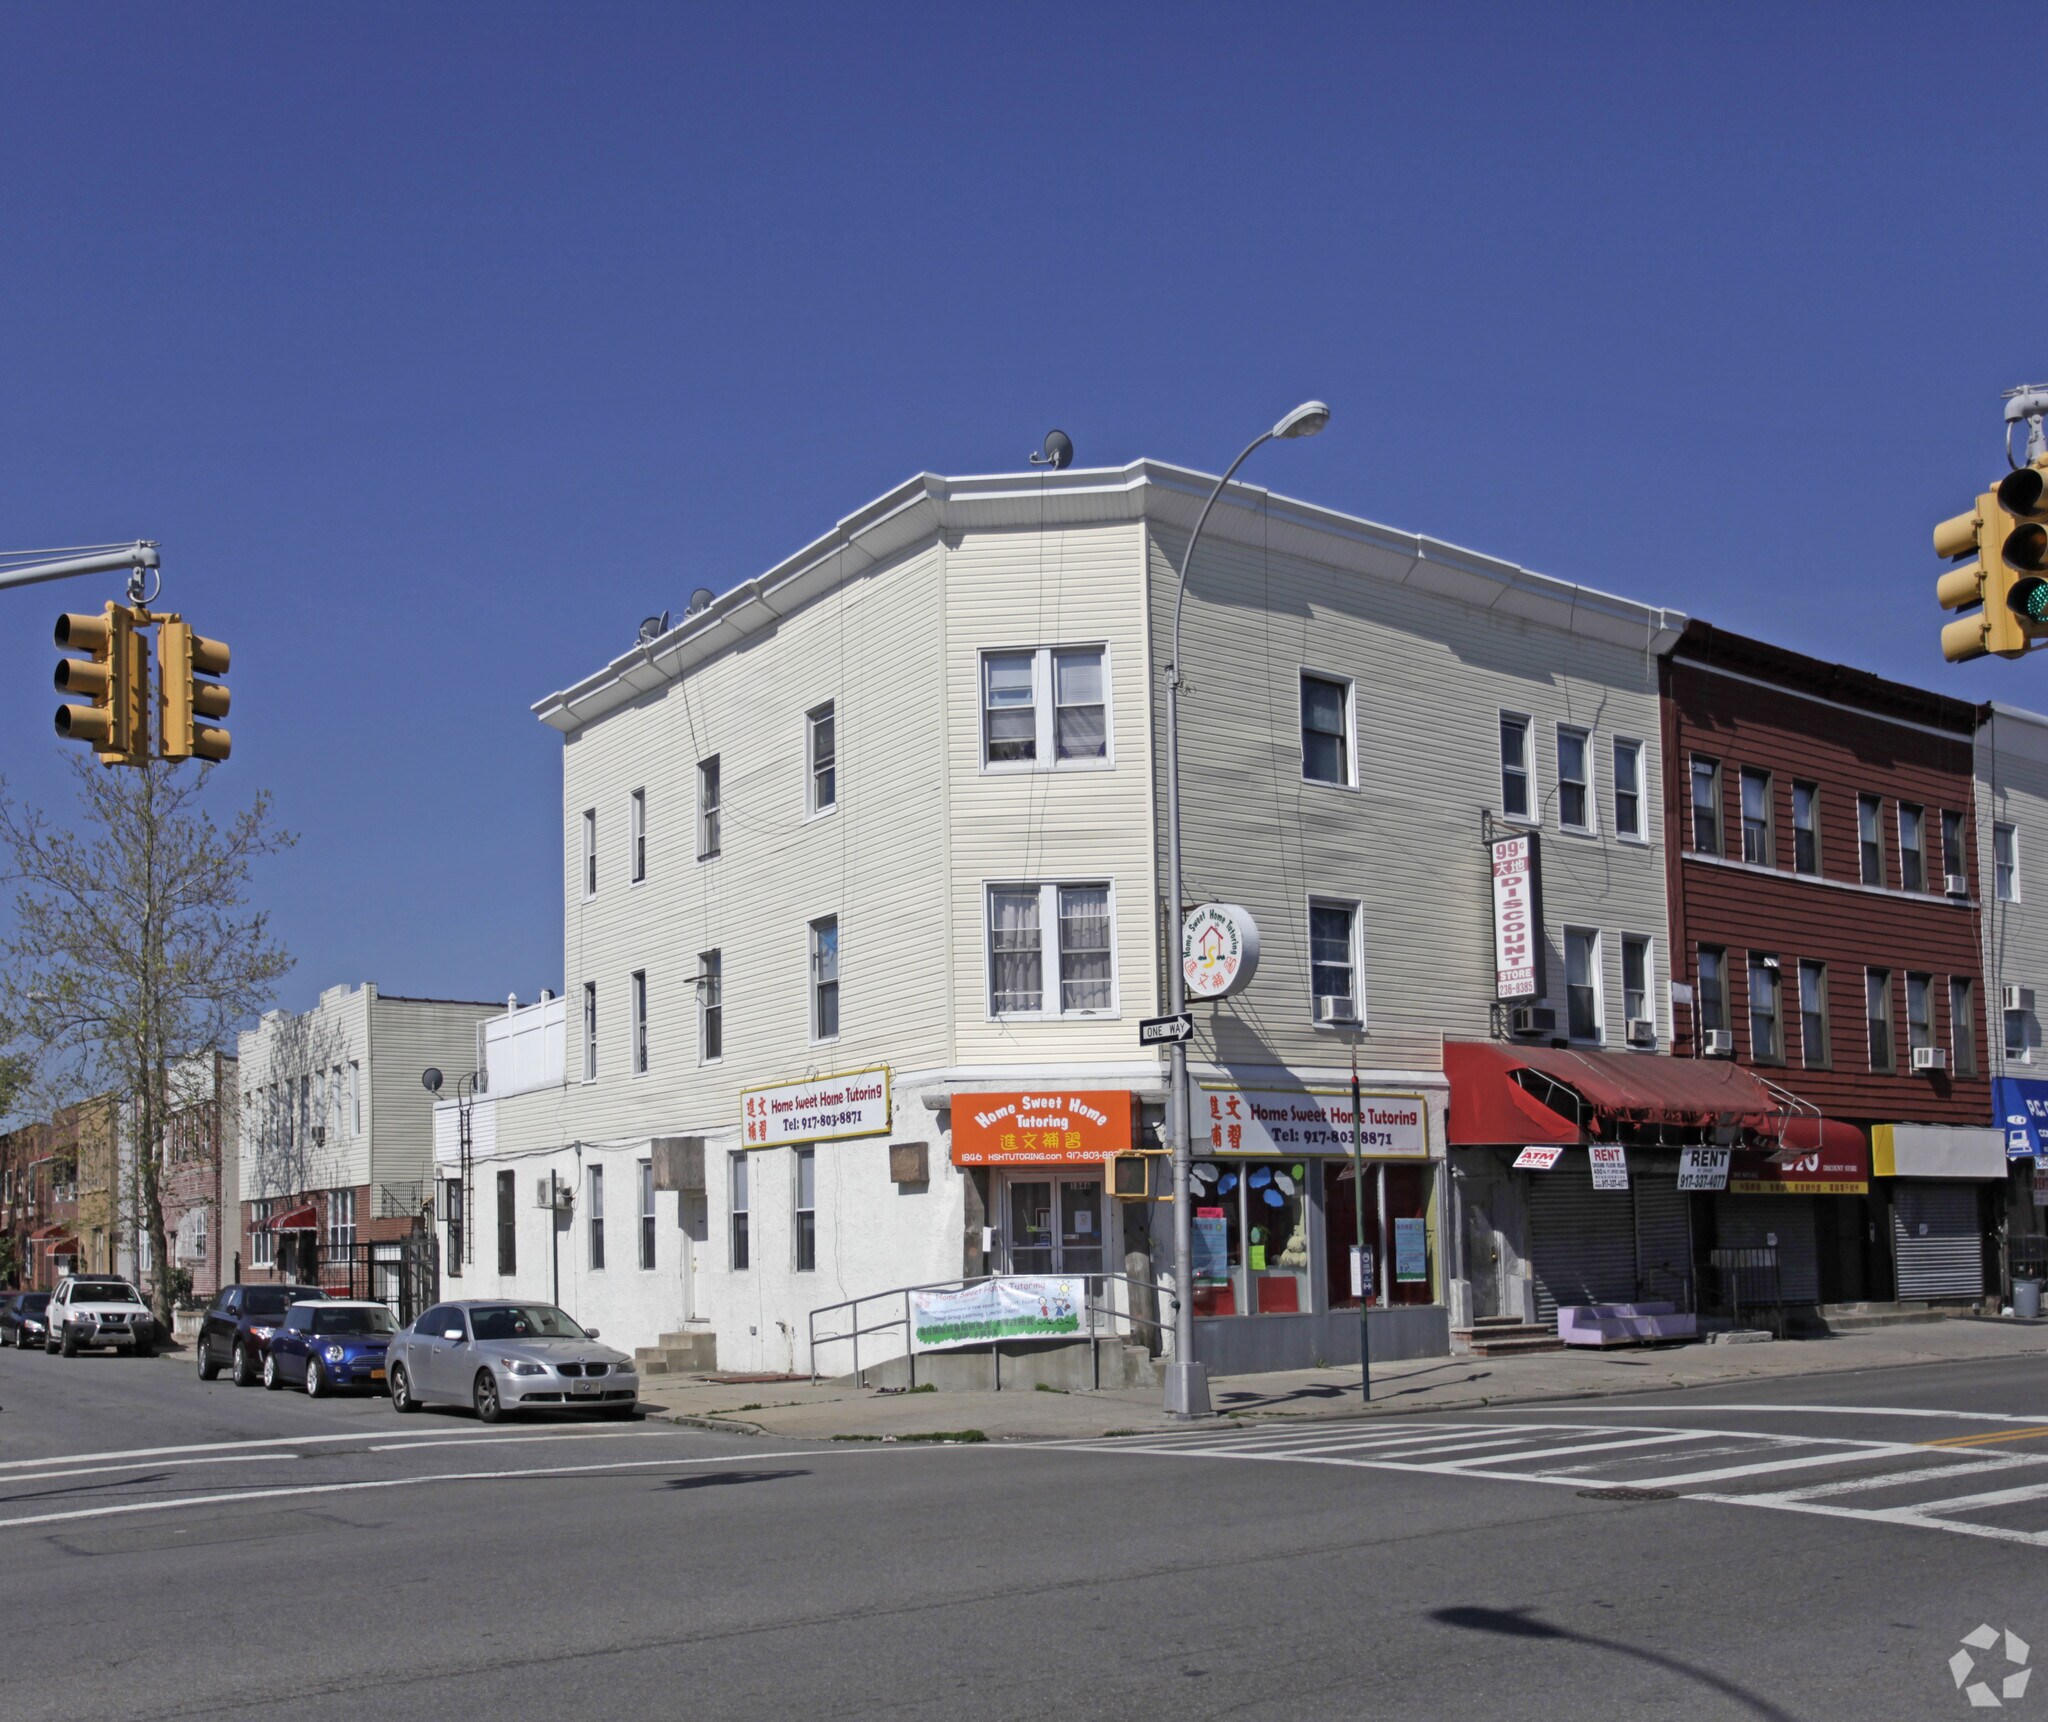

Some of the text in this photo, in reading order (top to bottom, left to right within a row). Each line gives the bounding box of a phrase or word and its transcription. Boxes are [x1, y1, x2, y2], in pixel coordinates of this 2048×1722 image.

[1496, 859, 1525, 876] 大地
[1501, 876, 1526, 966] DISCOUNT
[1183, 909, 1239, 958] Home Sweet Home Tutoring
[1499, 968, 1532, 982] STORE
[1147, 1022, 1185, 1037] ONE WAY
[771, 1084, 882, 1114] Home Sweet Home Tutoring
[974, 1095, 1108, 1128] Home Sweet Home
[1250, 1103, 1288, 1121] Home
[1290, 1105, 1327, 1123] Sweet
[1367, 1108, 1418, 1126] Tutoring
[783, 1110, 862, 1131] Tel: 917-803-8871
[1015, 1114, 1069, 1131] Tutoring
[1000, 1132, 1081, 1151] 進文補習
[1271, 1127, 1392, 1147] Tel: 917-8038871
[961, 1153, 983, 1162] 1846
[1520, 1151, 1555, 1160] ATM
[1594, 1149, 1620, 1161] RENT
[1690, 1150, 1727, 1167] RENT
[1822, 1164, 1844, 1172] DISCOUNT
[1680, 1174, 1726, 1188] 917-337-4077
[936, 1293, 957, 1301] Home
[960, 1288, 982, 1298] Sweet
[1009, 1282, 1045, 1292] Tutoring
